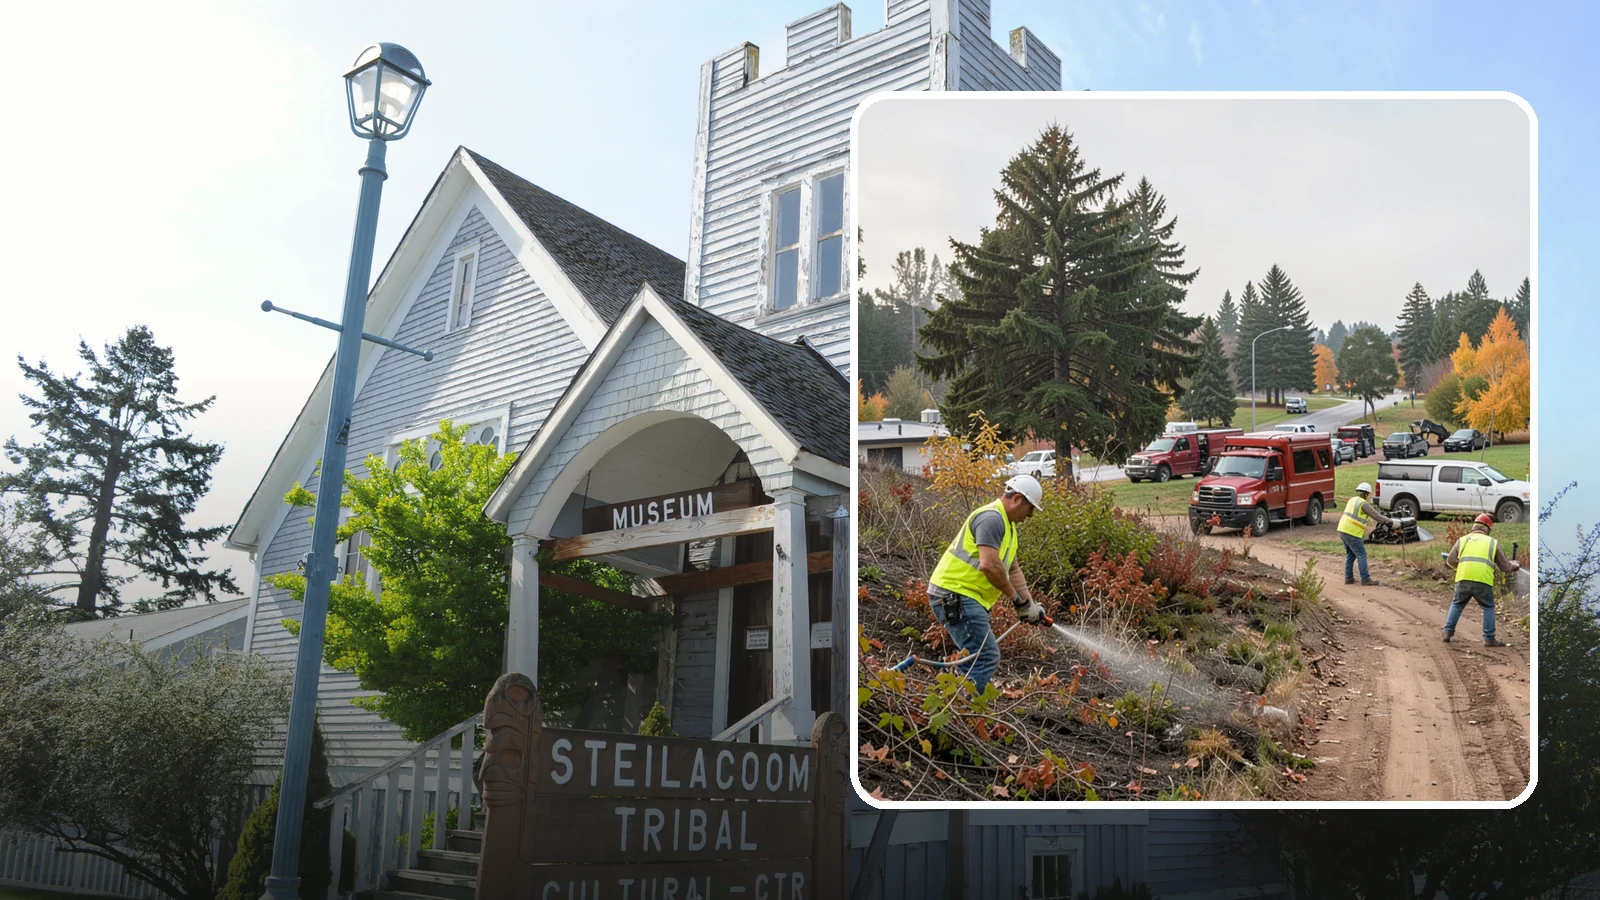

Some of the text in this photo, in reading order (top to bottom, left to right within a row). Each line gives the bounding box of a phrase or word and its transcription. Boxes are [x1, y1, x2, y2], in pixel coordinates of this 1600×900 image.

[612, 491, 714, 531] MUSEUM
[550, 738, 810, 792] STEILACOOM
[614, 806, 758, 852] TRIBAL
